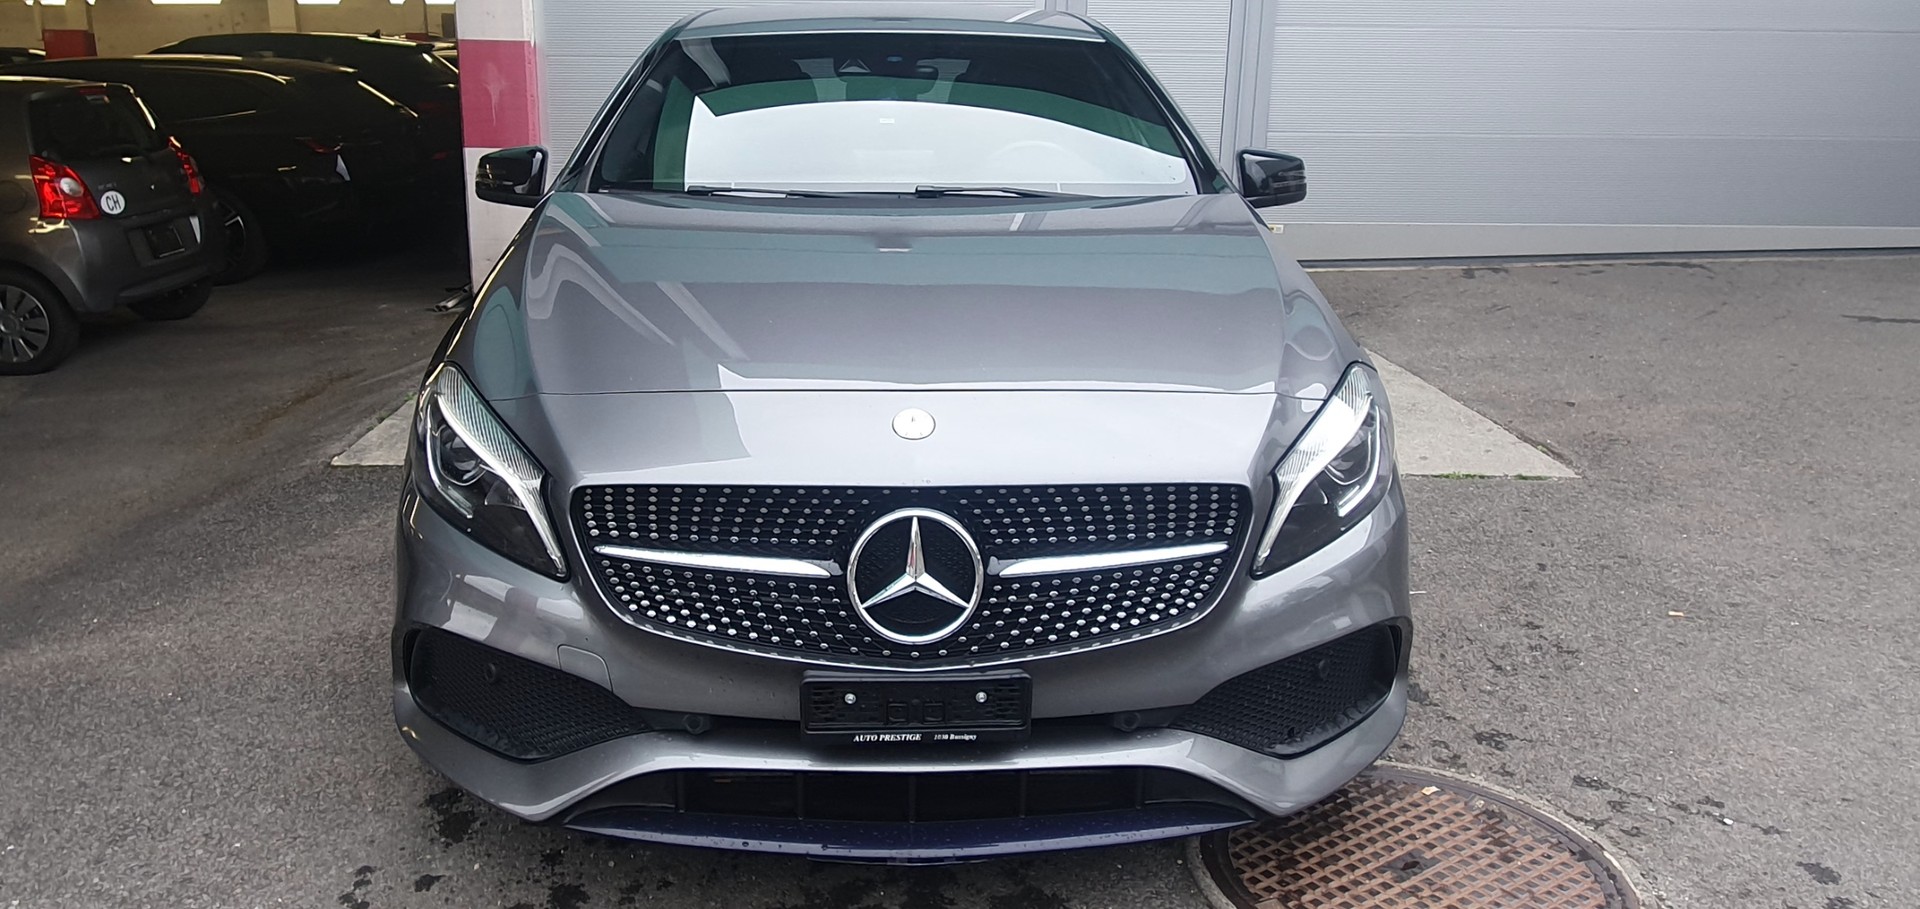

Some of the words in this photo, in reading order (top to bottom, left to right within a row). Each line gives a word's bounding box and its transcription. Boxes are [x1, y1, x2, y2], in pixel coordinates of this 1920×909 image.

[106, 194, 121, 211] CH
[853, 734, 878, 742] AUTO
[879, 733, 922, 741] PRESTIGE
